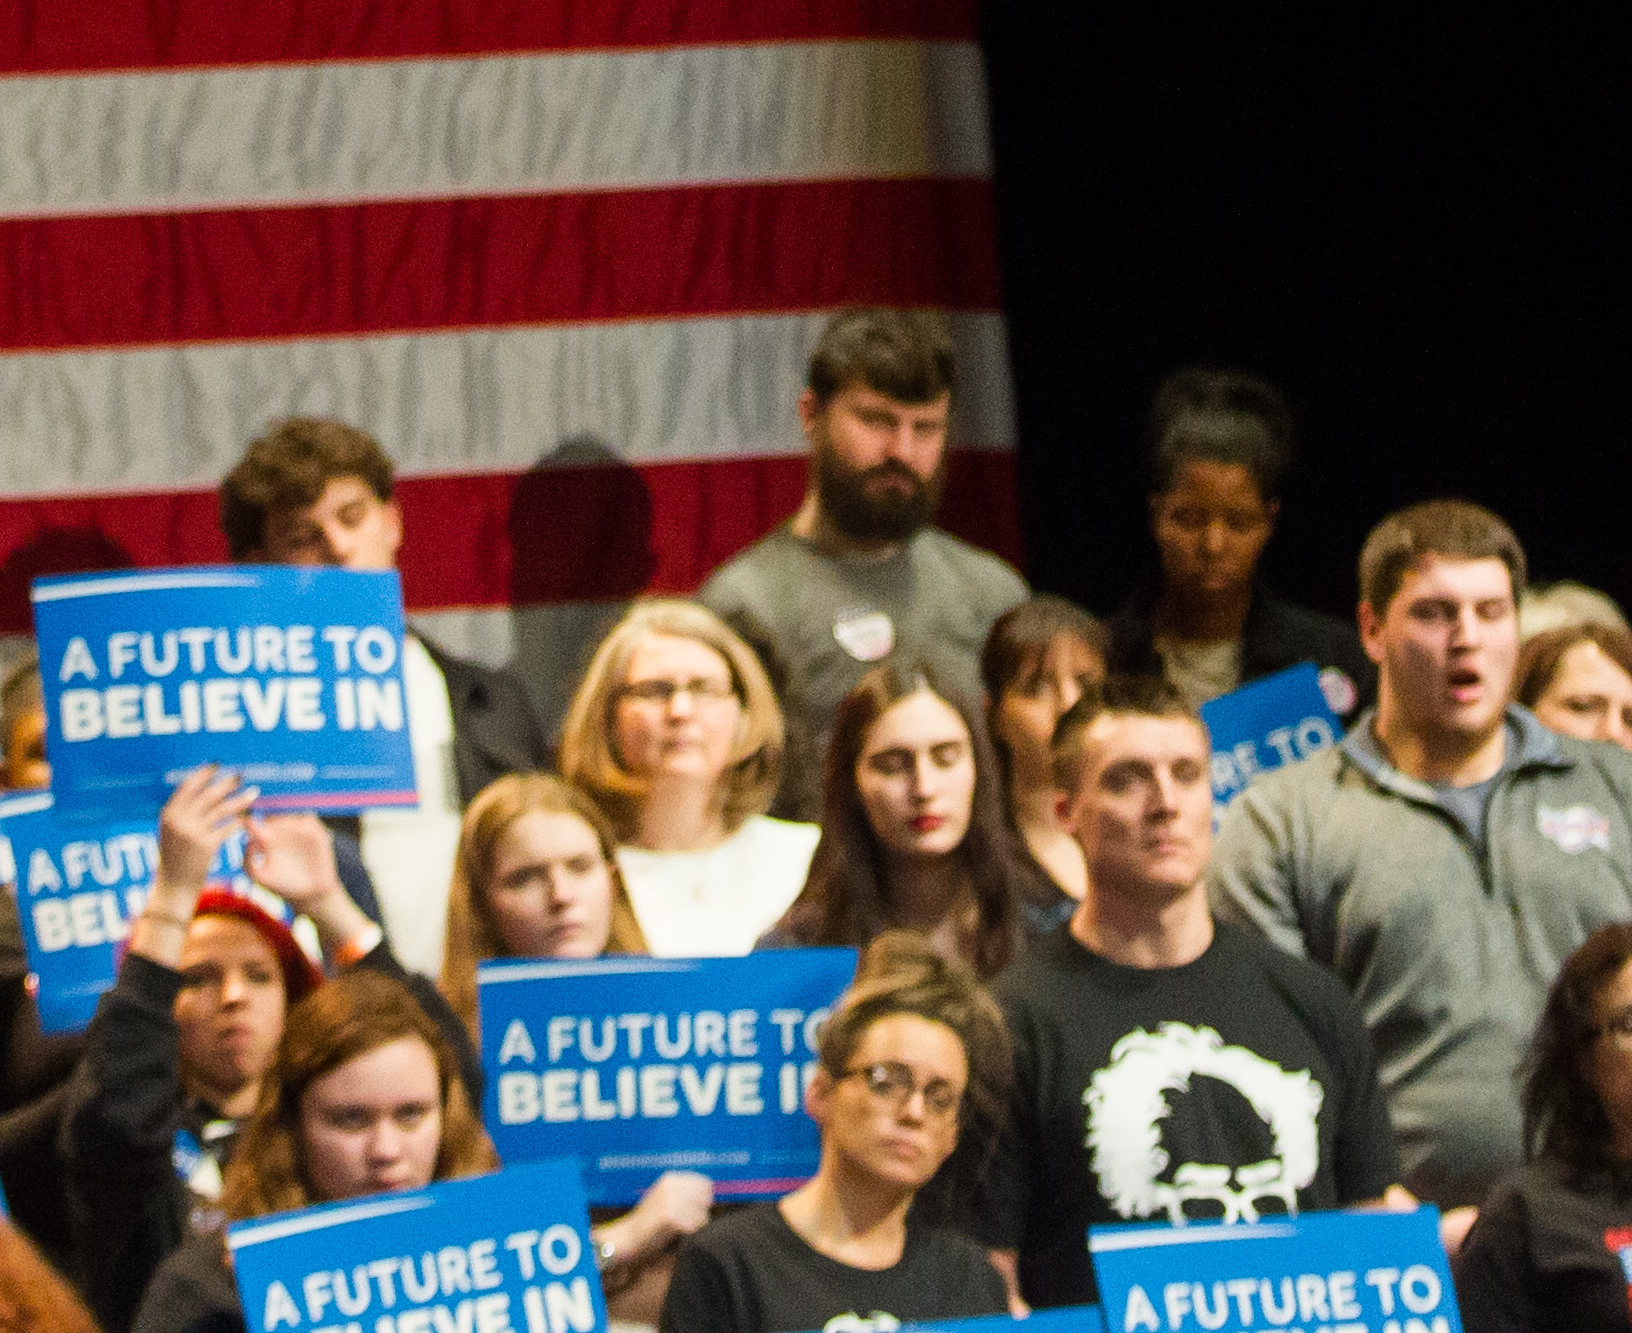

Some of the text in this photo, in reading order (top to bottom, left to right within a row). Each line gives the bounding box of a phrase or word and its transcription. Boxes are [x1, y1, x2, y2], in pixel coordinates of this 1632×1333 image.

[59, 624, 398, 684] A FUTURE TO
[60, 676, 404, 743] BELIEVE IN
[28, 847, 63, 897] A
[498, 1018, 536, 1065] A
[546, 1008, 760, 1063] FUTURE
[497, 1060, 765, 1125] BELIEVE
[262, 1223, 583, 1333] A FUTURE TO
[522, 1275, 596, 1333] IN
[1124, 1263, 1443, 1333] A FUTURE TO
